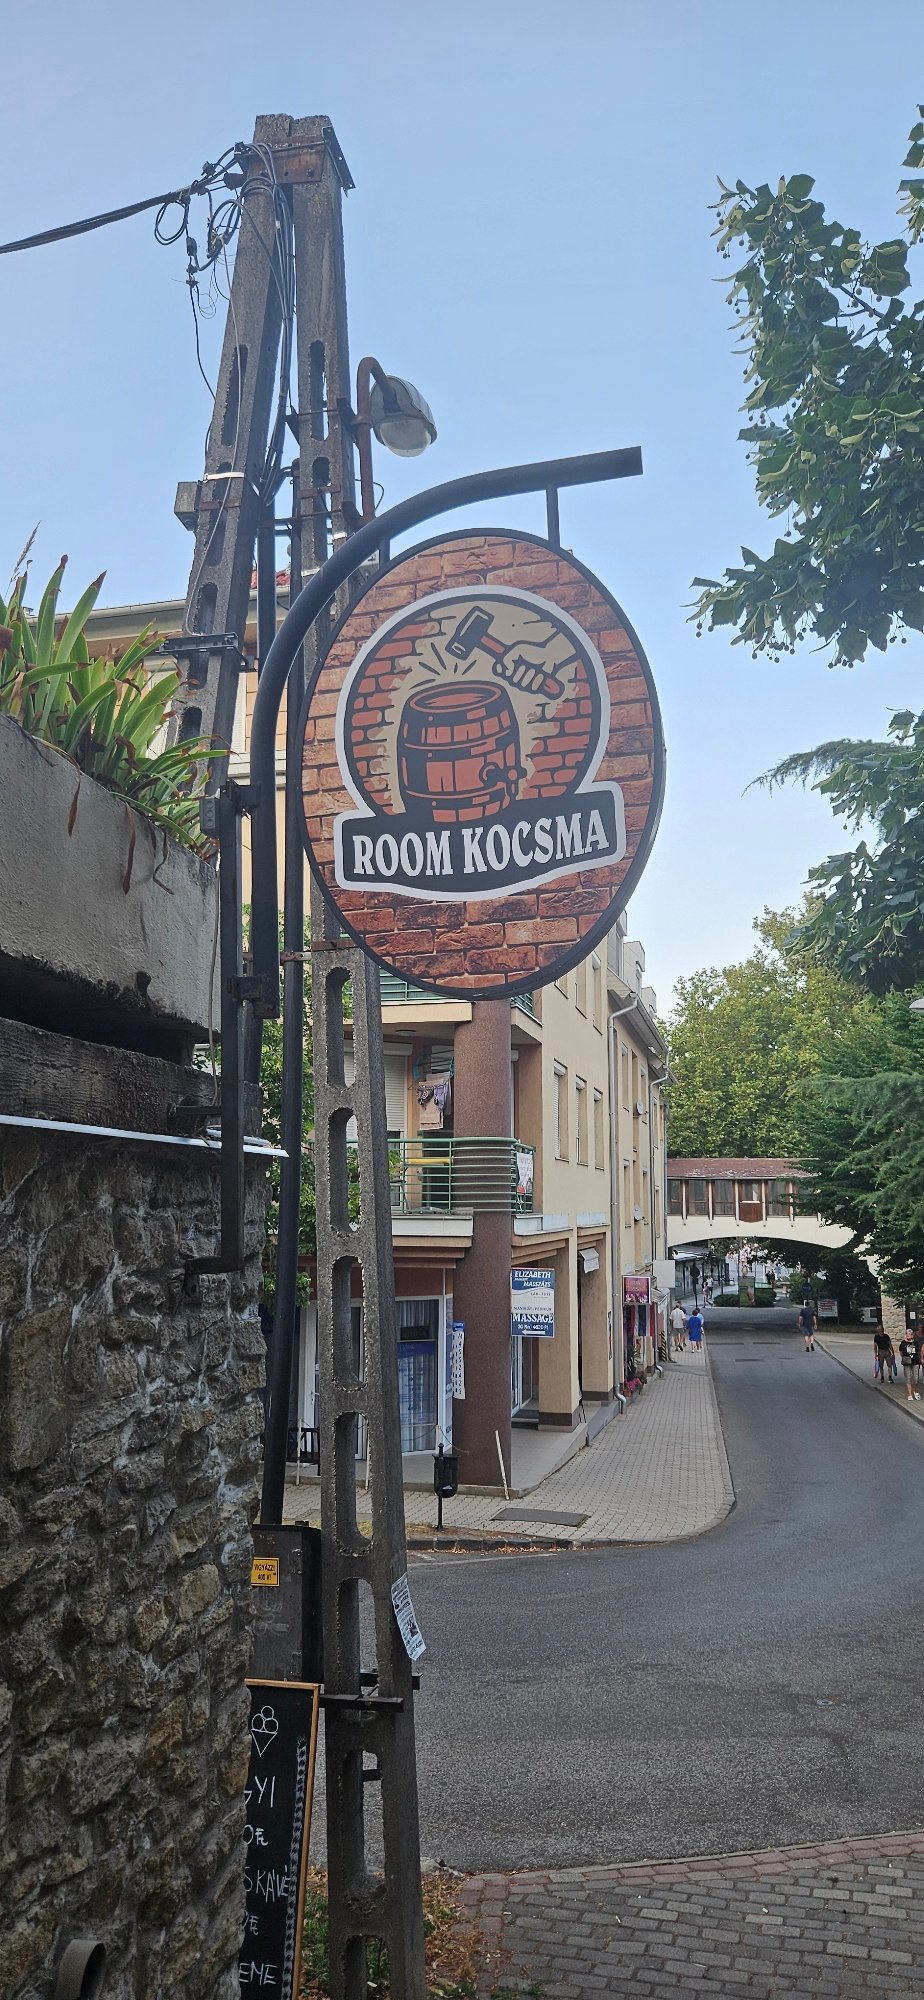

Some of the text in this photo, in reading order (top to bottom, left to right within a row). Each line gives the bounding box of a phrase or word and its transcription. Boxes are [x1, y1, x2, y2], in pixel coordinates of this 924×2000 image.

[352, 809, 610, 877] ROOM KOCSMA
[512, 1313, 554, 1323] MASSAGE
